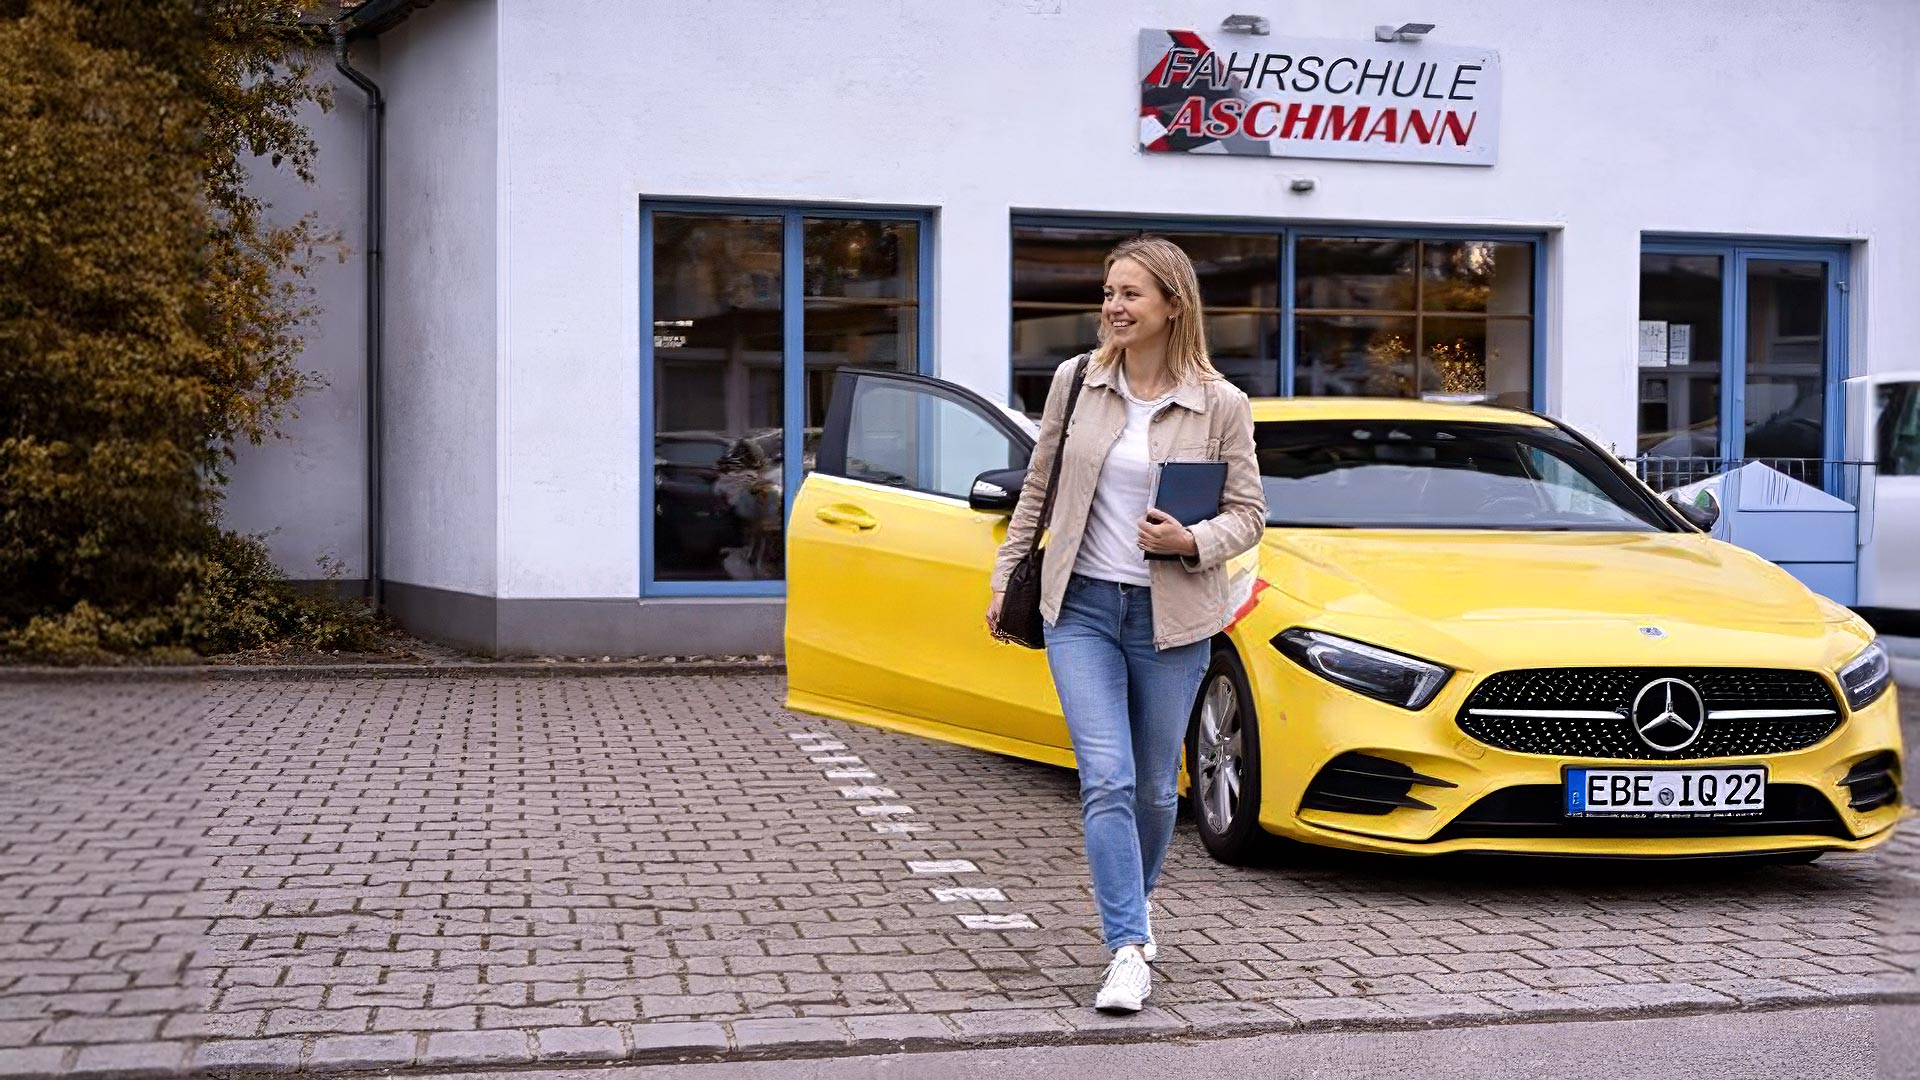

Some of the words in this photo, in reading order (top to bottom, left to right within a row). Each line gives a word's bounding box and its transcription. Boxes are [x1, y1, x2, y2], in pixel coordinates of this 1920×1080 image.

[1160, 47, 1482, 100] FAHRSCHULE
[1167, 96, 1477, 146] ASCHMANN
[1588, 775, 1653, 806] EBE
[1679, 774, 1718, 807] IQ
[1725, 773, 1762, 806] 22
